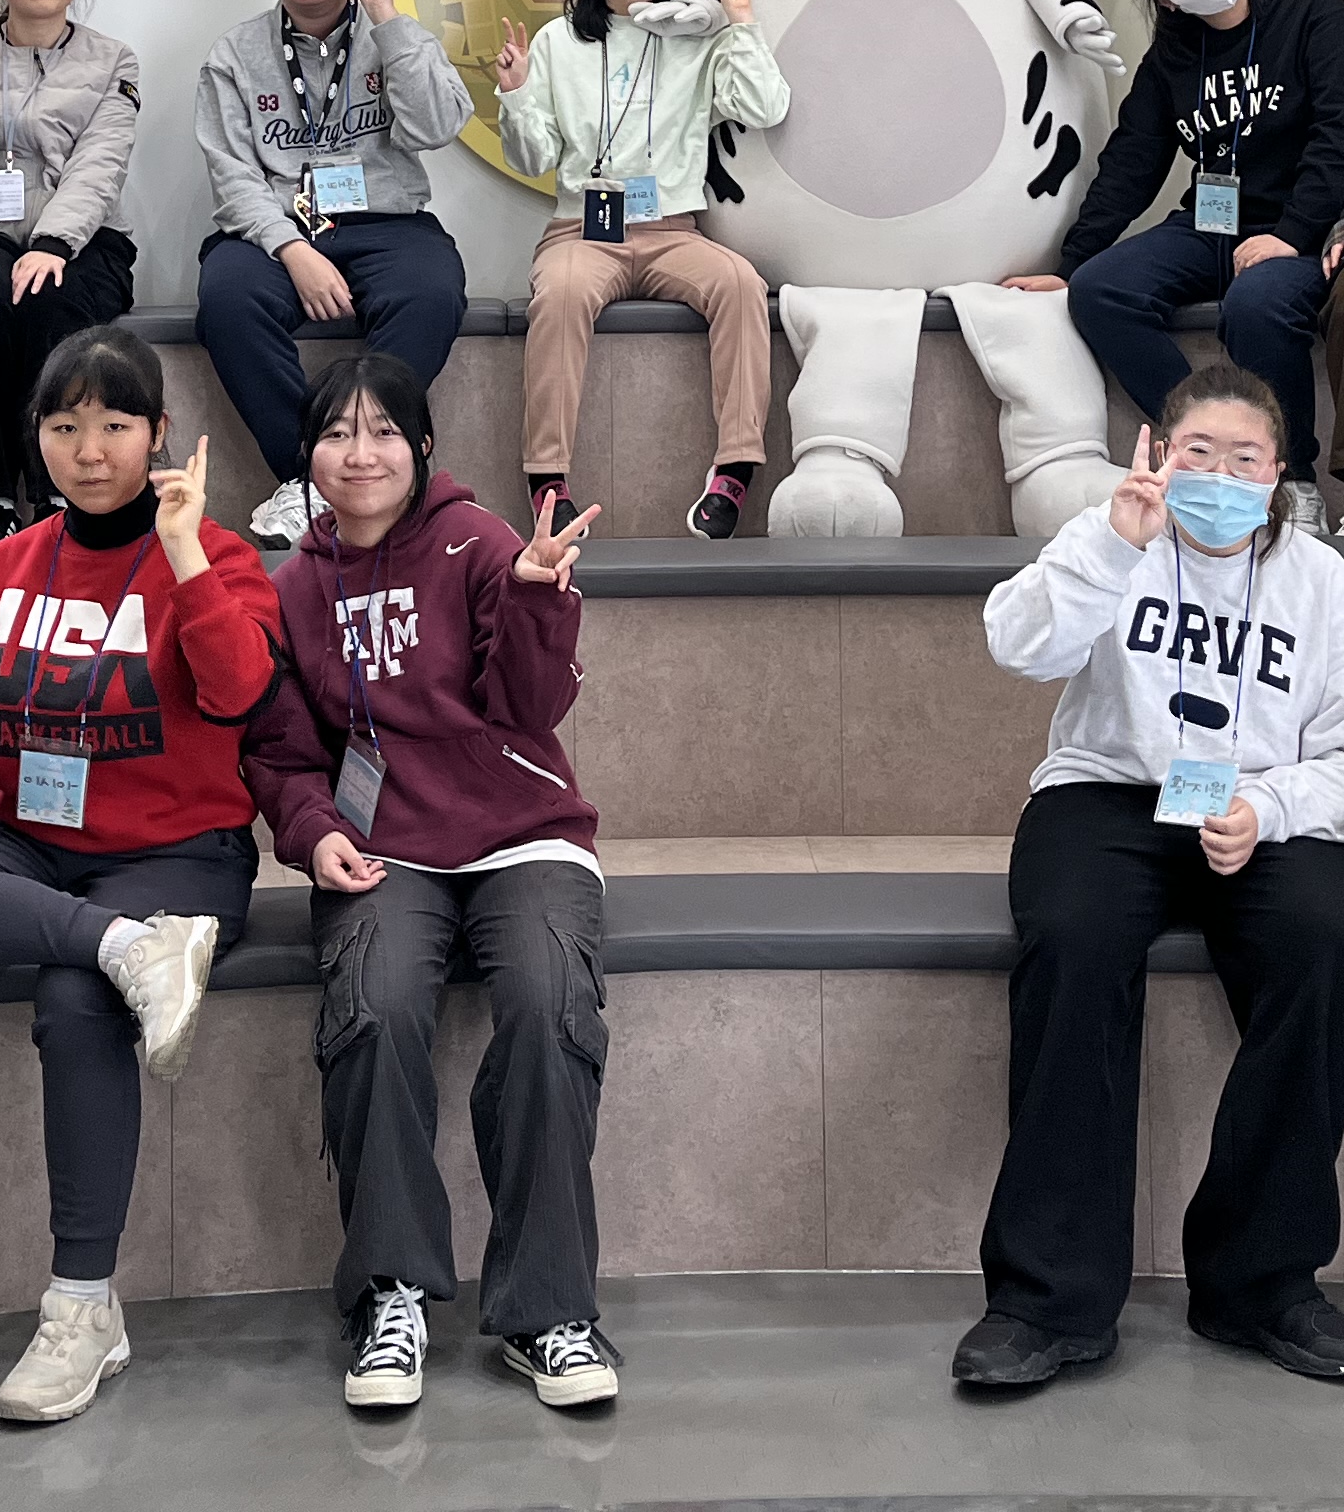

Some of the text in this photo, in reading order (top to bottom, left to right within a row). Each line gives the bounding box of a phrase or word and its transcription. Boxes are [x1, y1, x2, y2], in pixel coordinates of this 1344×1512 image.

[1204, 63, 1260, 100] NEW
[256, 93, 279, 112] 93
[342, 96, 387, 134] Club
[1126, 596, 1297, 693] GRVE
